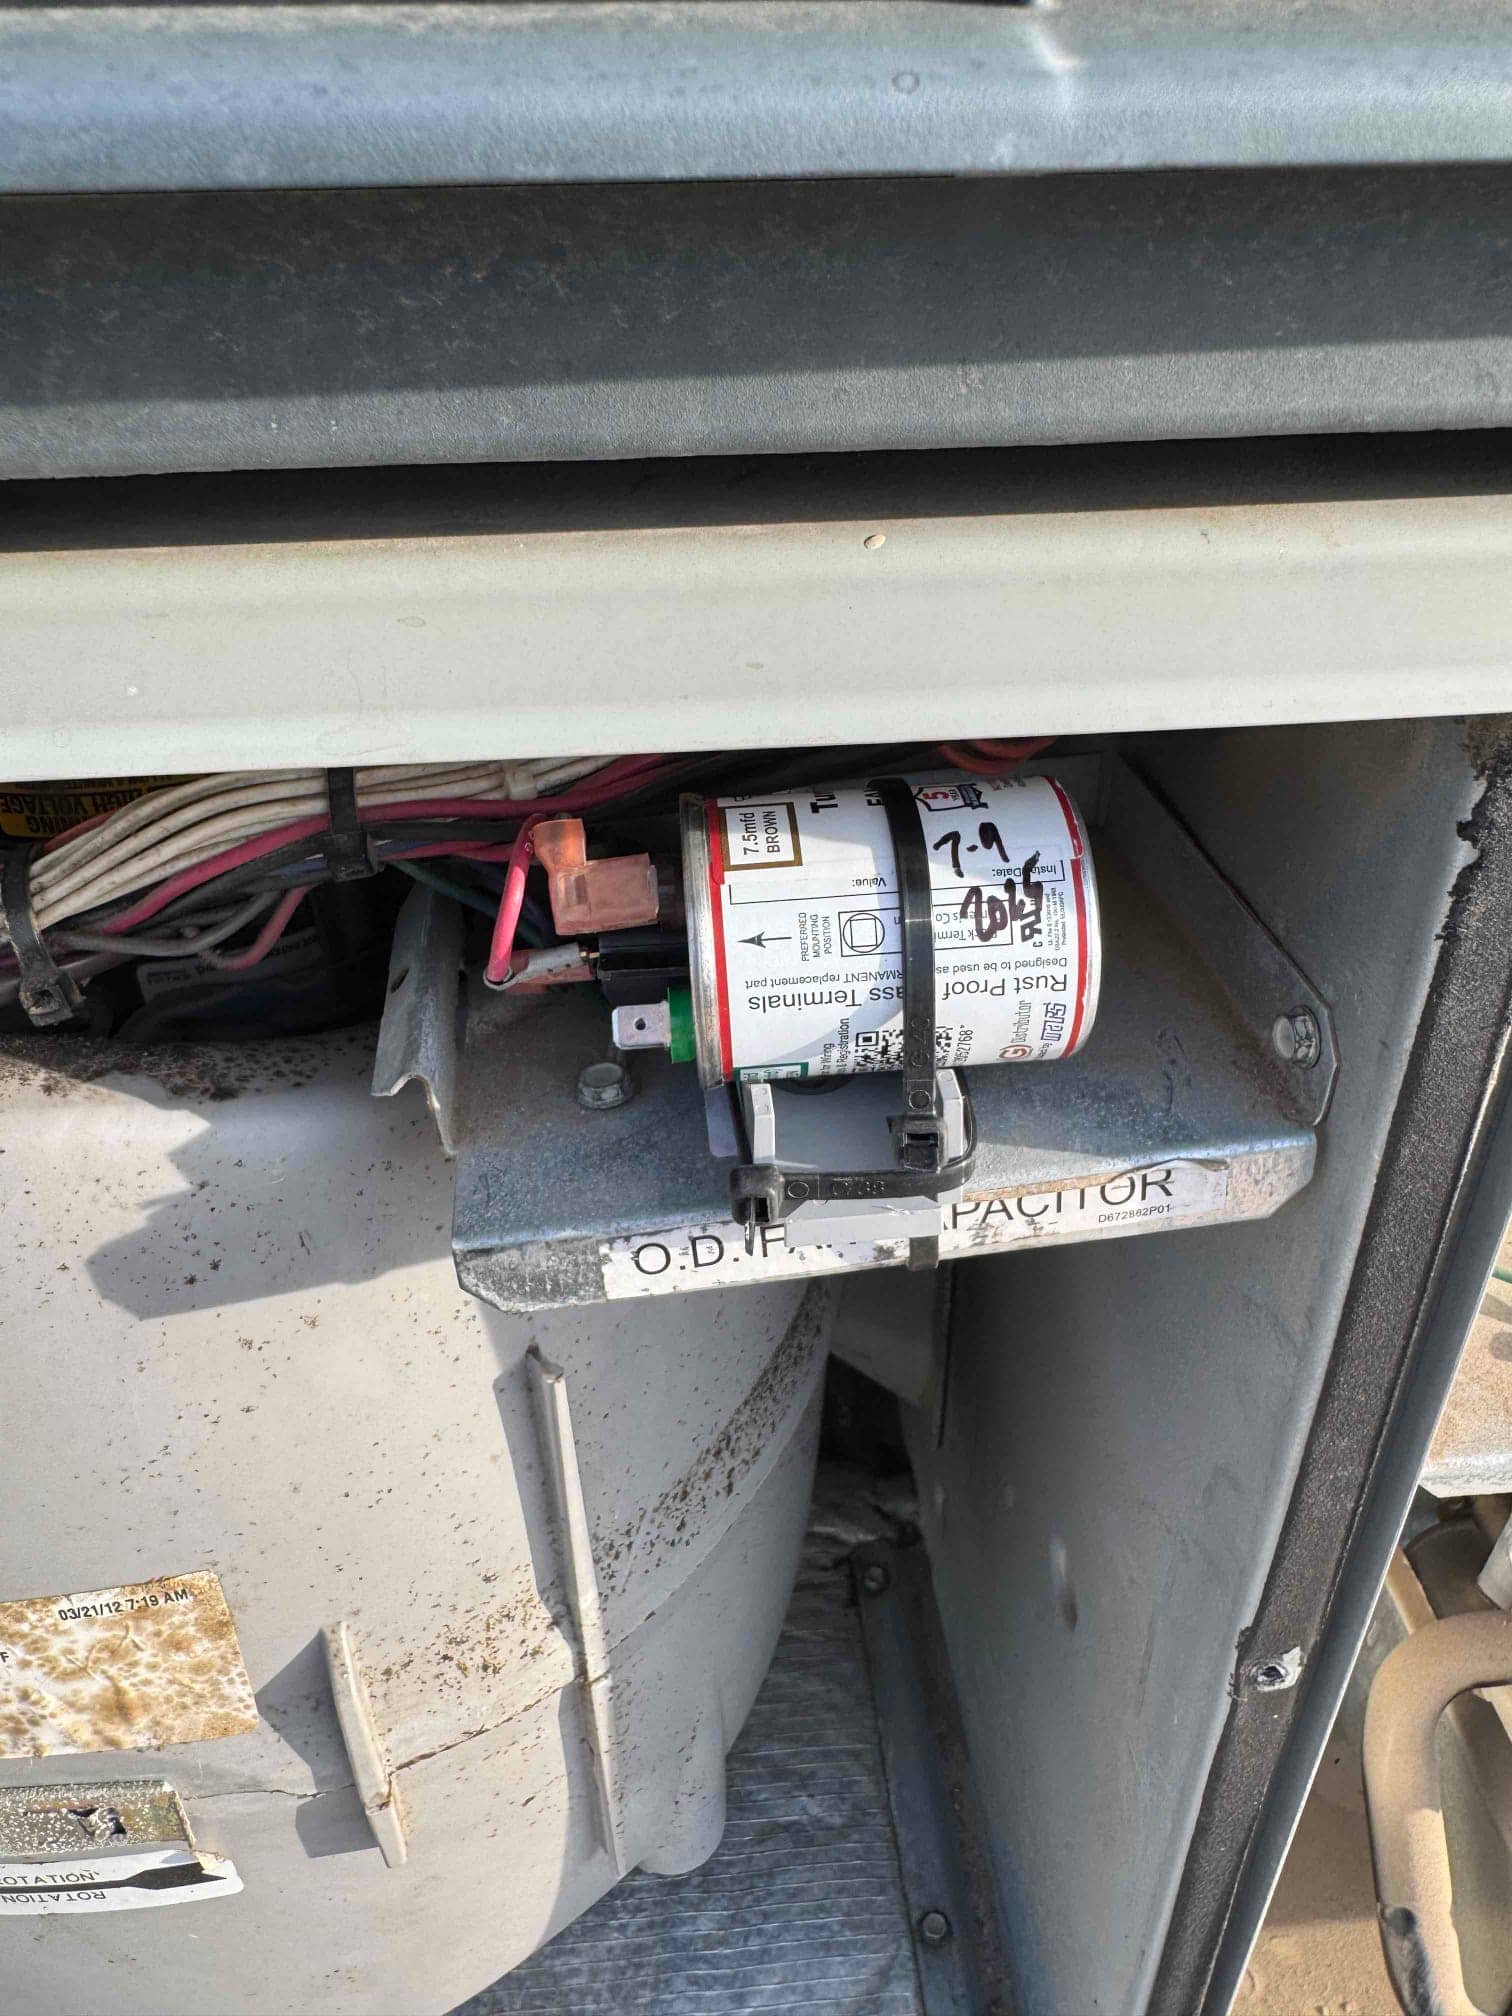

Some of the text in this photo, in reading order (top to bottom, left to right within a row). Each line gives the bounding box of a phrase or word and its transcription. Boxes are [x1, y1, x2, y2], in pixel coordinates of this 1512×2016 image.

[921, 791, 951, 801] 5
[739, 812, 759, 855] 7.5mfd
[762, 810, 781, 853] BROWN
[852, 877, 887, 888] Value:
[991, 867, 1022, 878] Date:
[809, 913, 821, 958] MOUNTING
[821, 915, 832, 955] POSITION
[744, 957, 1068, 990] Designed to be used as RMANENT replacement part
[748, 973, 1068, 1014] Rust Proof ass Terminals
[633, 1234, 740, 1275] O.D.
[58, 1588, 190, 1621] 03/21/12 7:19 AM
[0, 1890, 107, 1904] ROTATION
